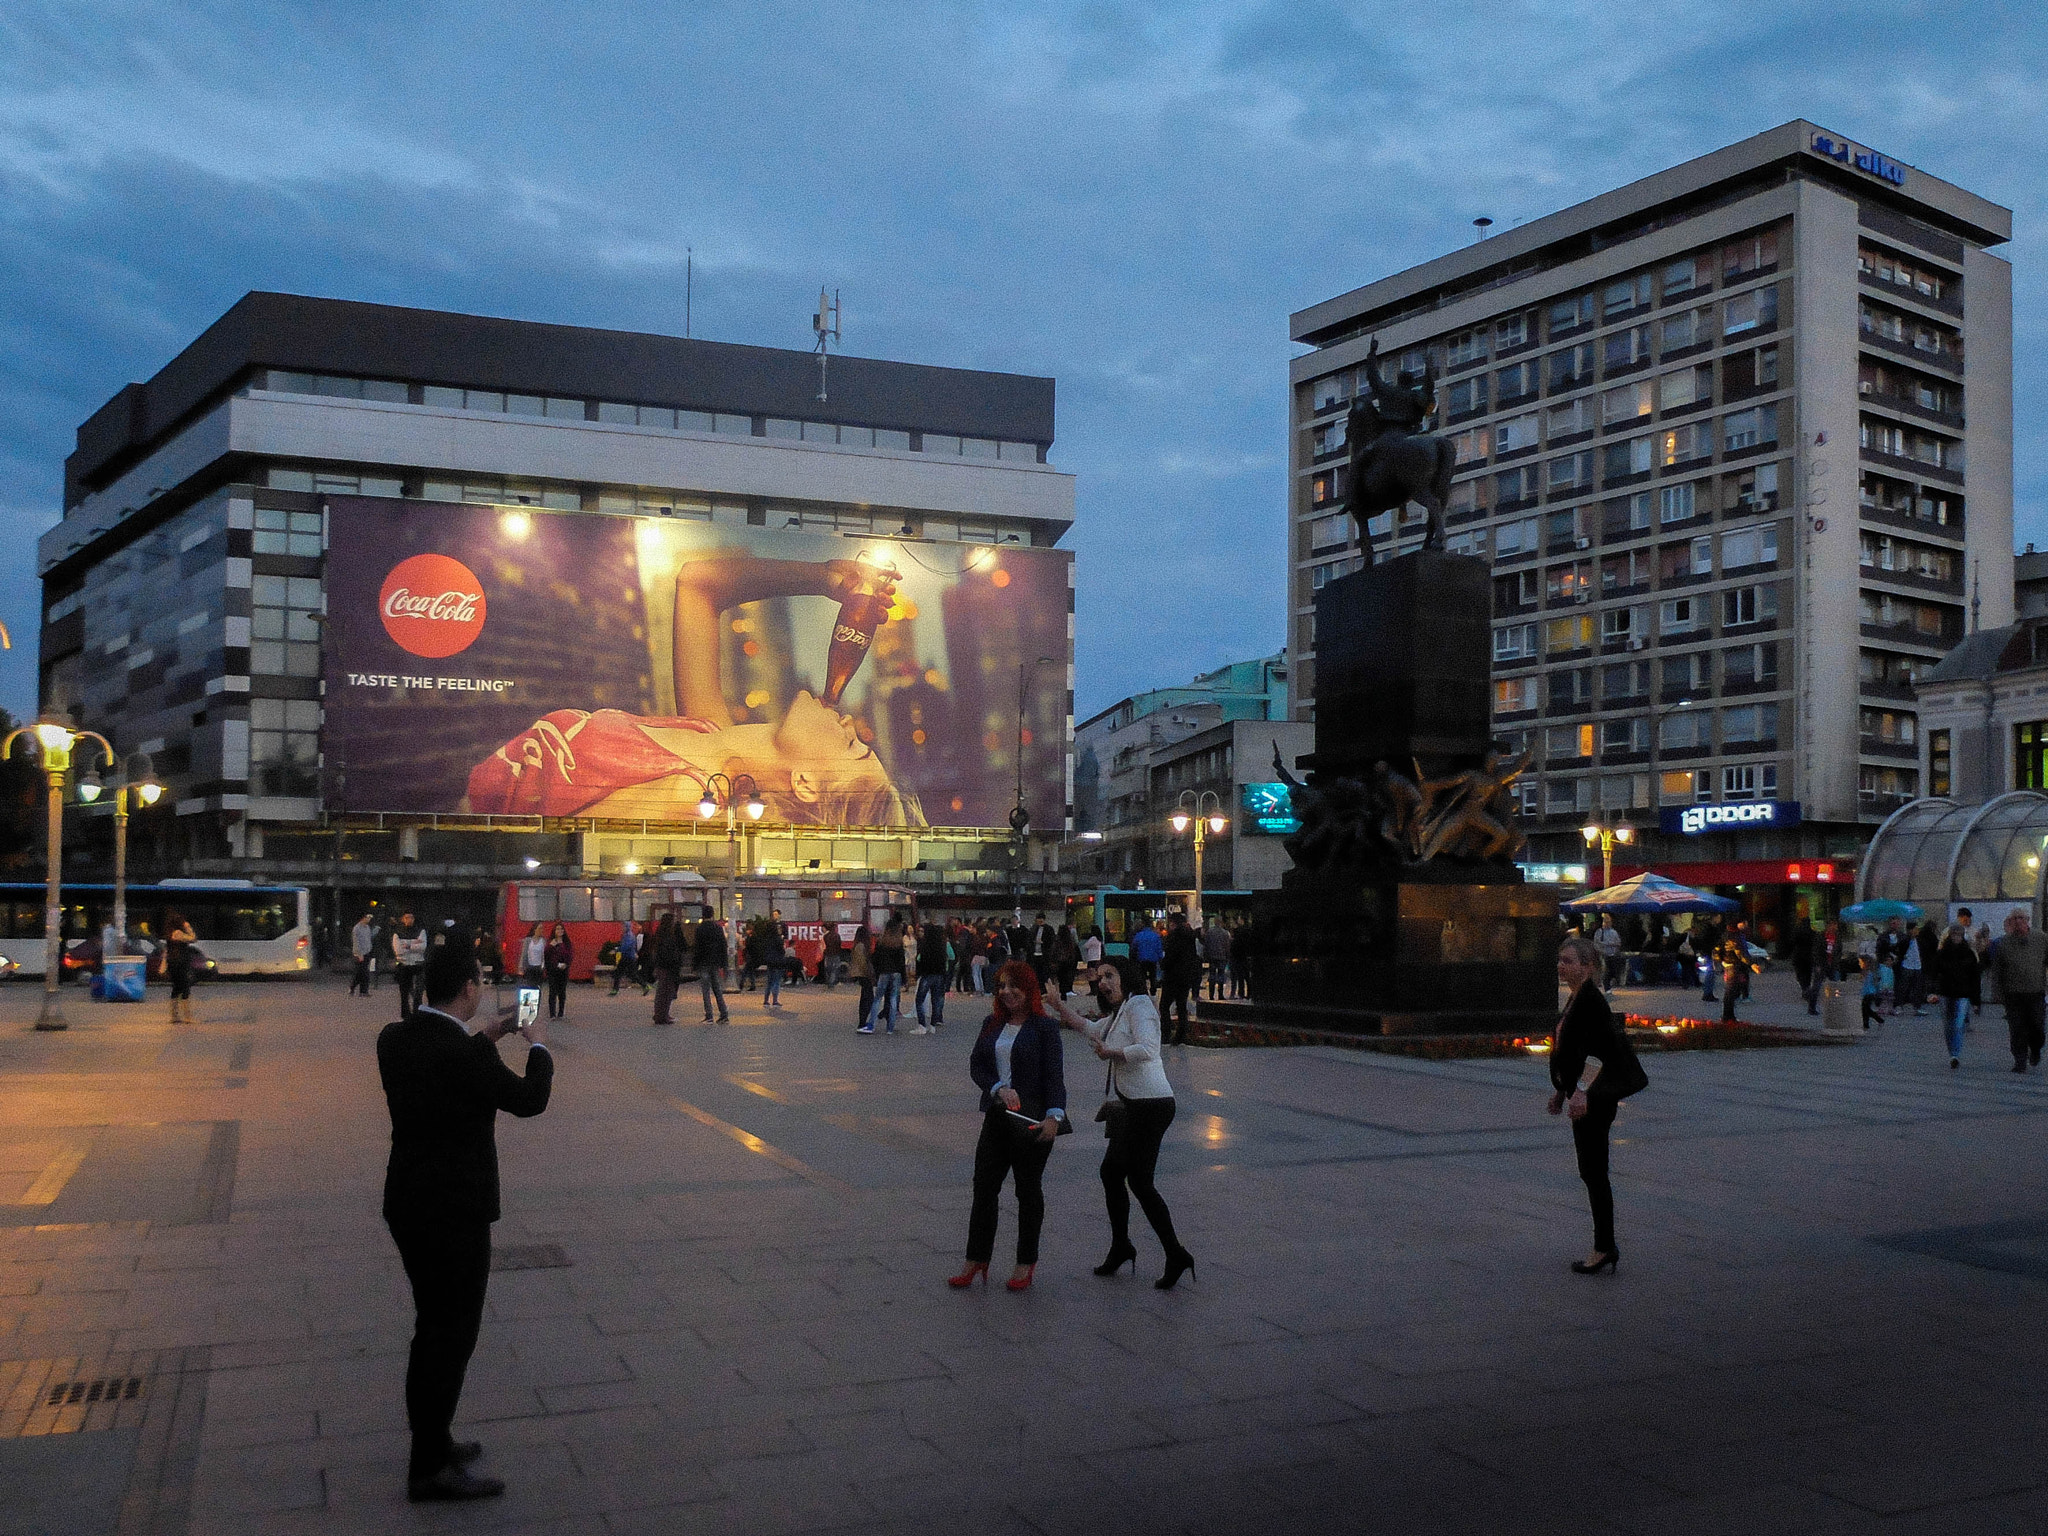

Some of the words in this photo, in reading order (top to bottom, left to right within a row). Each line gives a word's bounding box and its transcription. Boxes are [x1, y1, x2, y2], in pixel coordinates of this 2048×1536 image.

[385, 588, 482, 622] Coca-Cola
[348, 673, 398, 688] TASTE
[402, 676, 433, 689] THE
[1706, 803, 1773, 823] DDOR
